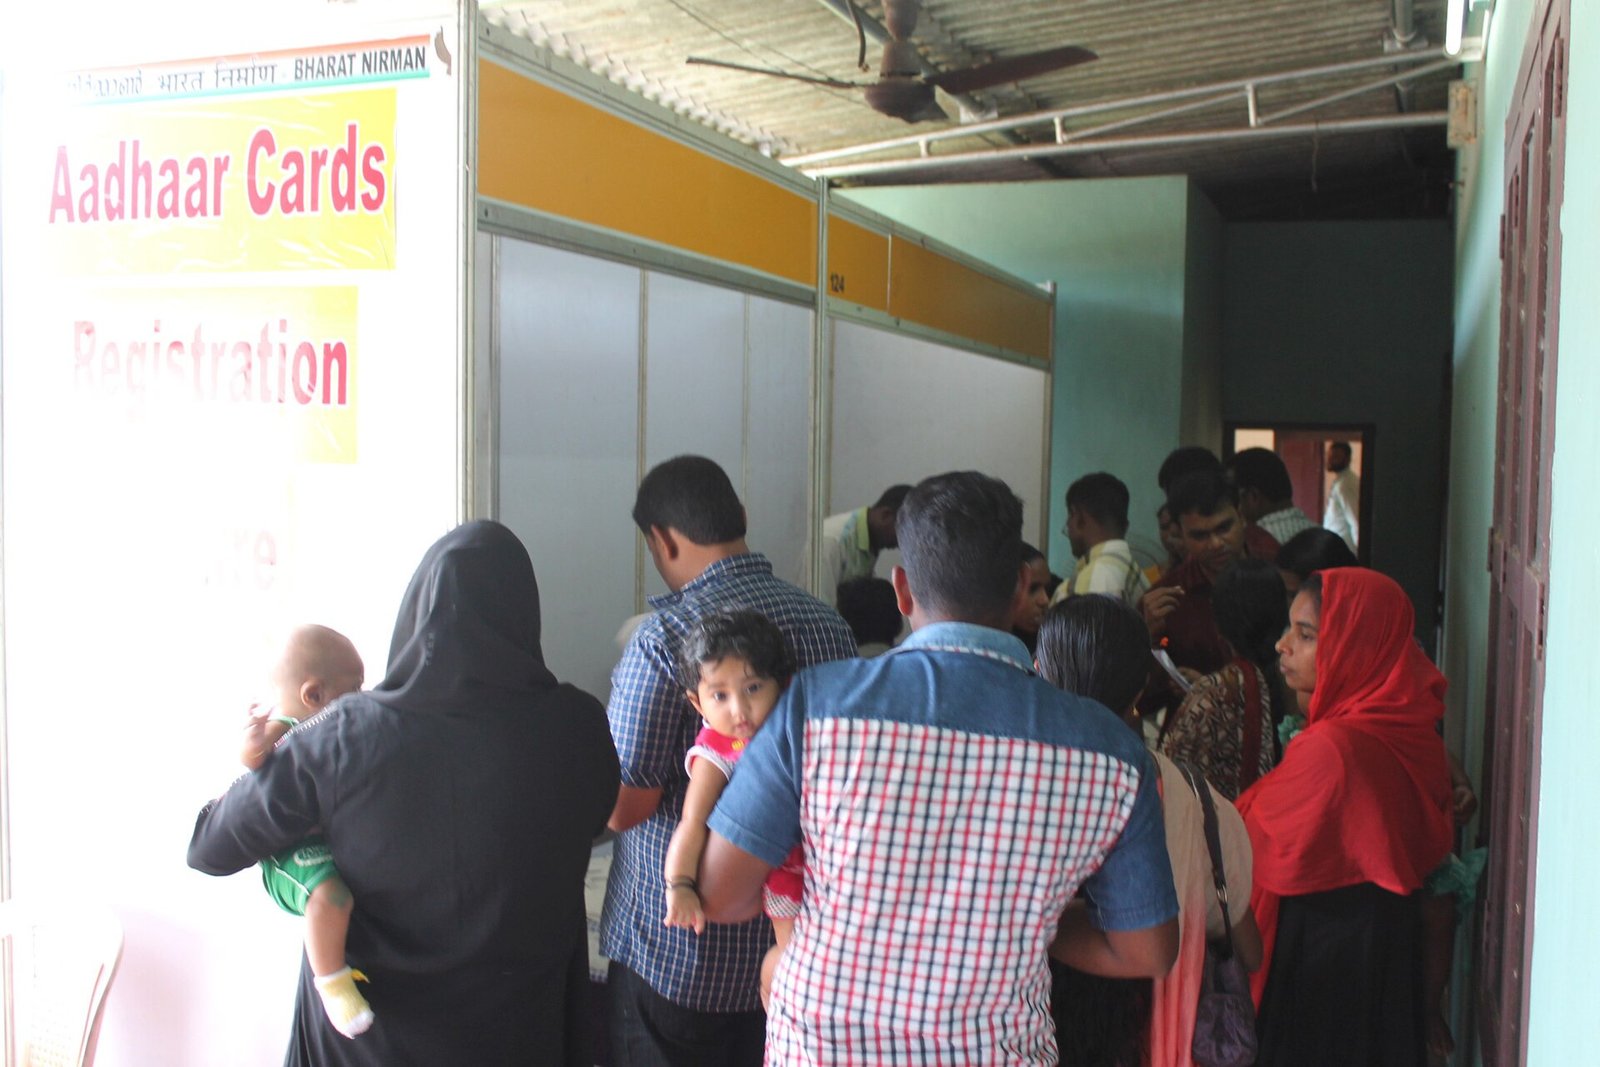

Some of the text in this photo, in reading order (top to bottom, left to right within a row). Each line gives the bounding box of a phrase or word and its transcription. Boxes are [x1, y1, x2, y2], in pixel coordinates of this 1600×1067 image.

[158, 70, 205, 93] भारत
[293, 46, 427, 82] BHARAT NIRMAN
[49, 122, 387, 225] Aadhaar Cards
[72, 317, 349, 423] Registration
